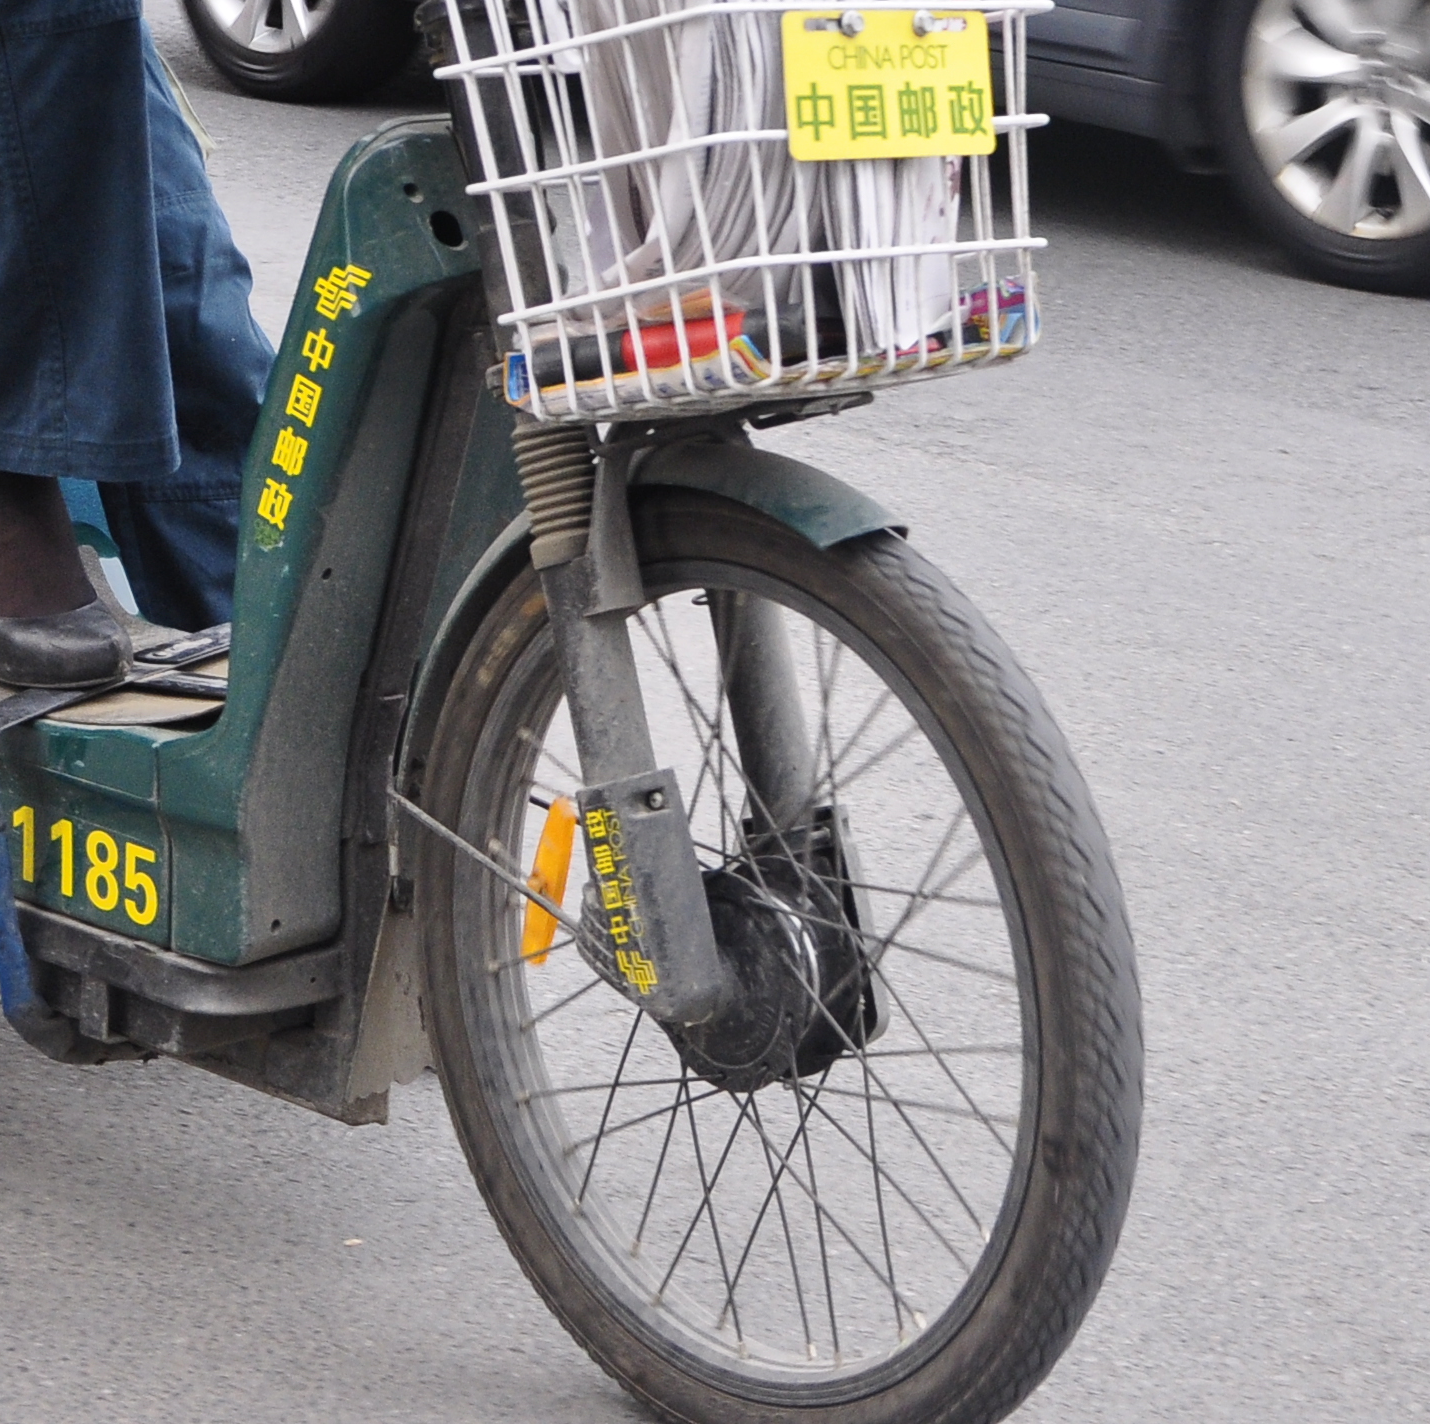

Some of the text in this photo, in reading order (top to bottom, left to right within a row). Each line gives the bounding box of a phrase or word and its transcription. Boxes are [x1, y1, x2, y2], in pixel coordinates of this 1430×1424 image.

[795, 81, 988, 142] 中国邮政
[827, 44, 948, 70] CHINA POST
[257, 328, 336, 531] 中国邮政
[12, 805, 159, 927] 1185
[584, 808, 632, 946] 中国邮政
[605, 809, 644, 938] CHINA POST
